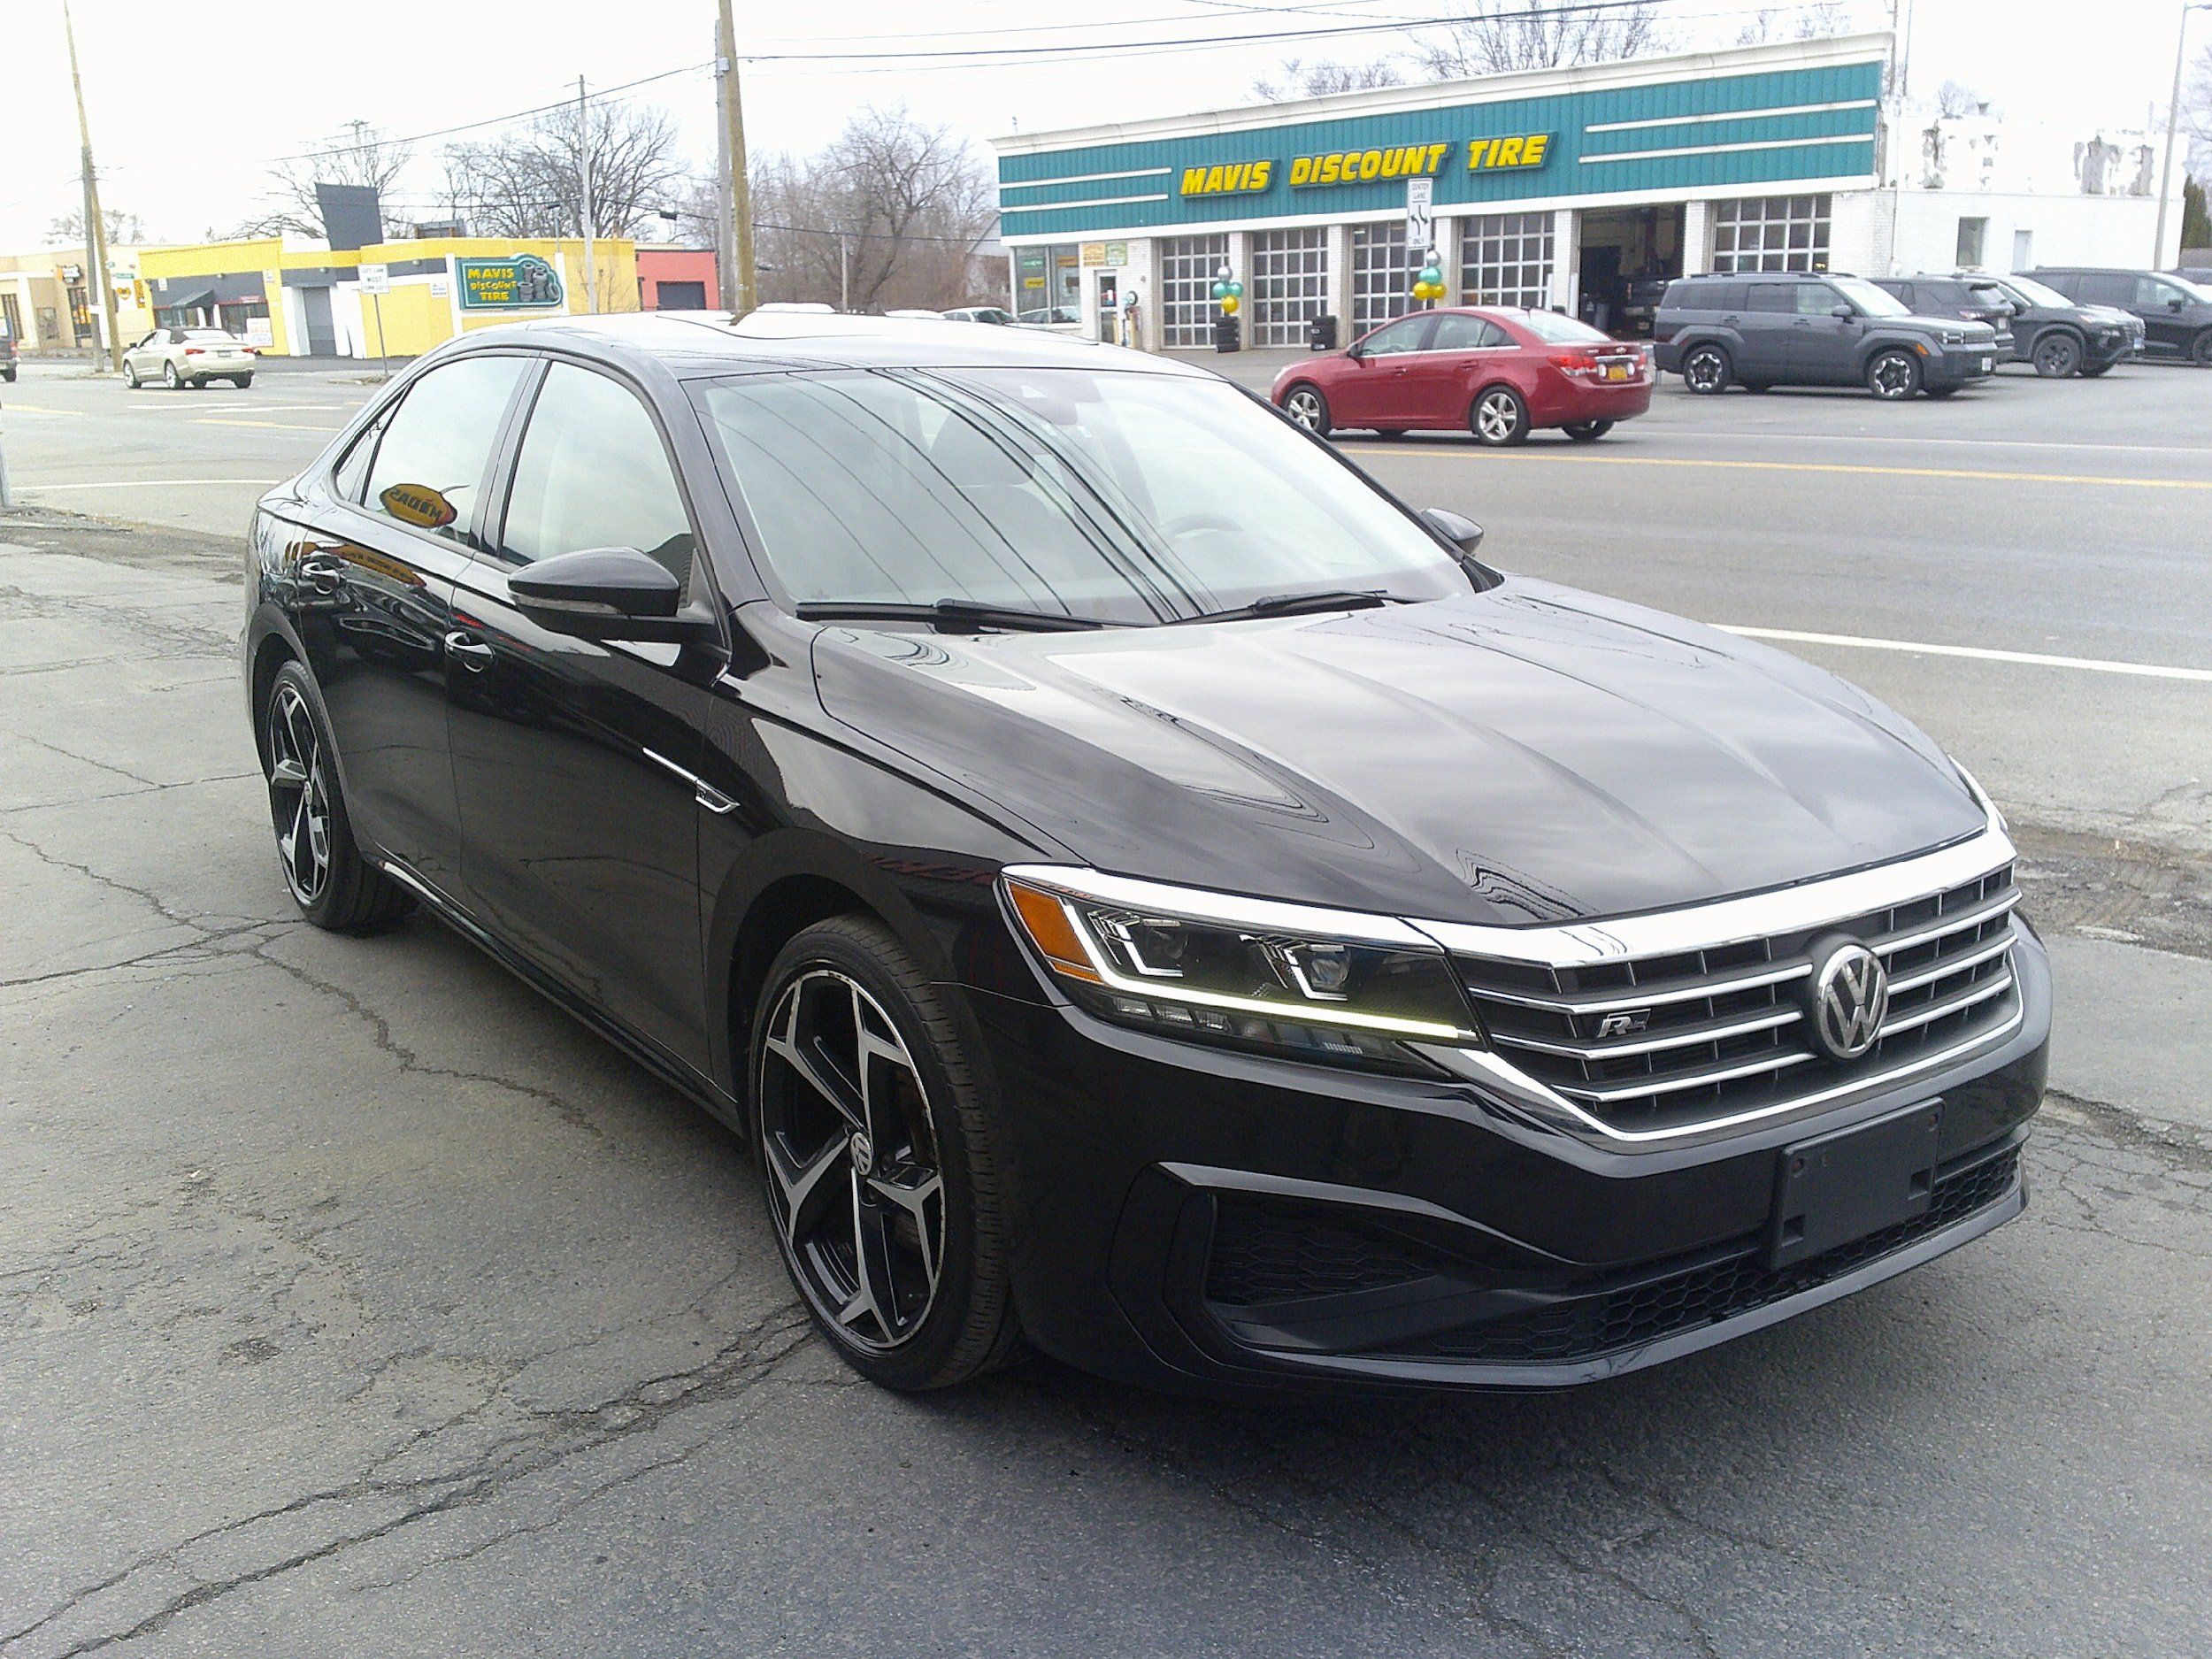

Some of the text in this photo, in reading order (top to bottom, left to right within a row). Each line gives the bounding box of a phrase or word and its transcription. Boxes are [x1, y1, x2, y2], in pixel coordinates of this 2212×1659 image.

[1179, 134, 1550, 196] MAVIS DISCOUNT TIRE
[467, 268, 514, 279] MAVIS
[470, 280, 518, 290] DISCOUNT
[480, 291, 510, 301] TIRE
